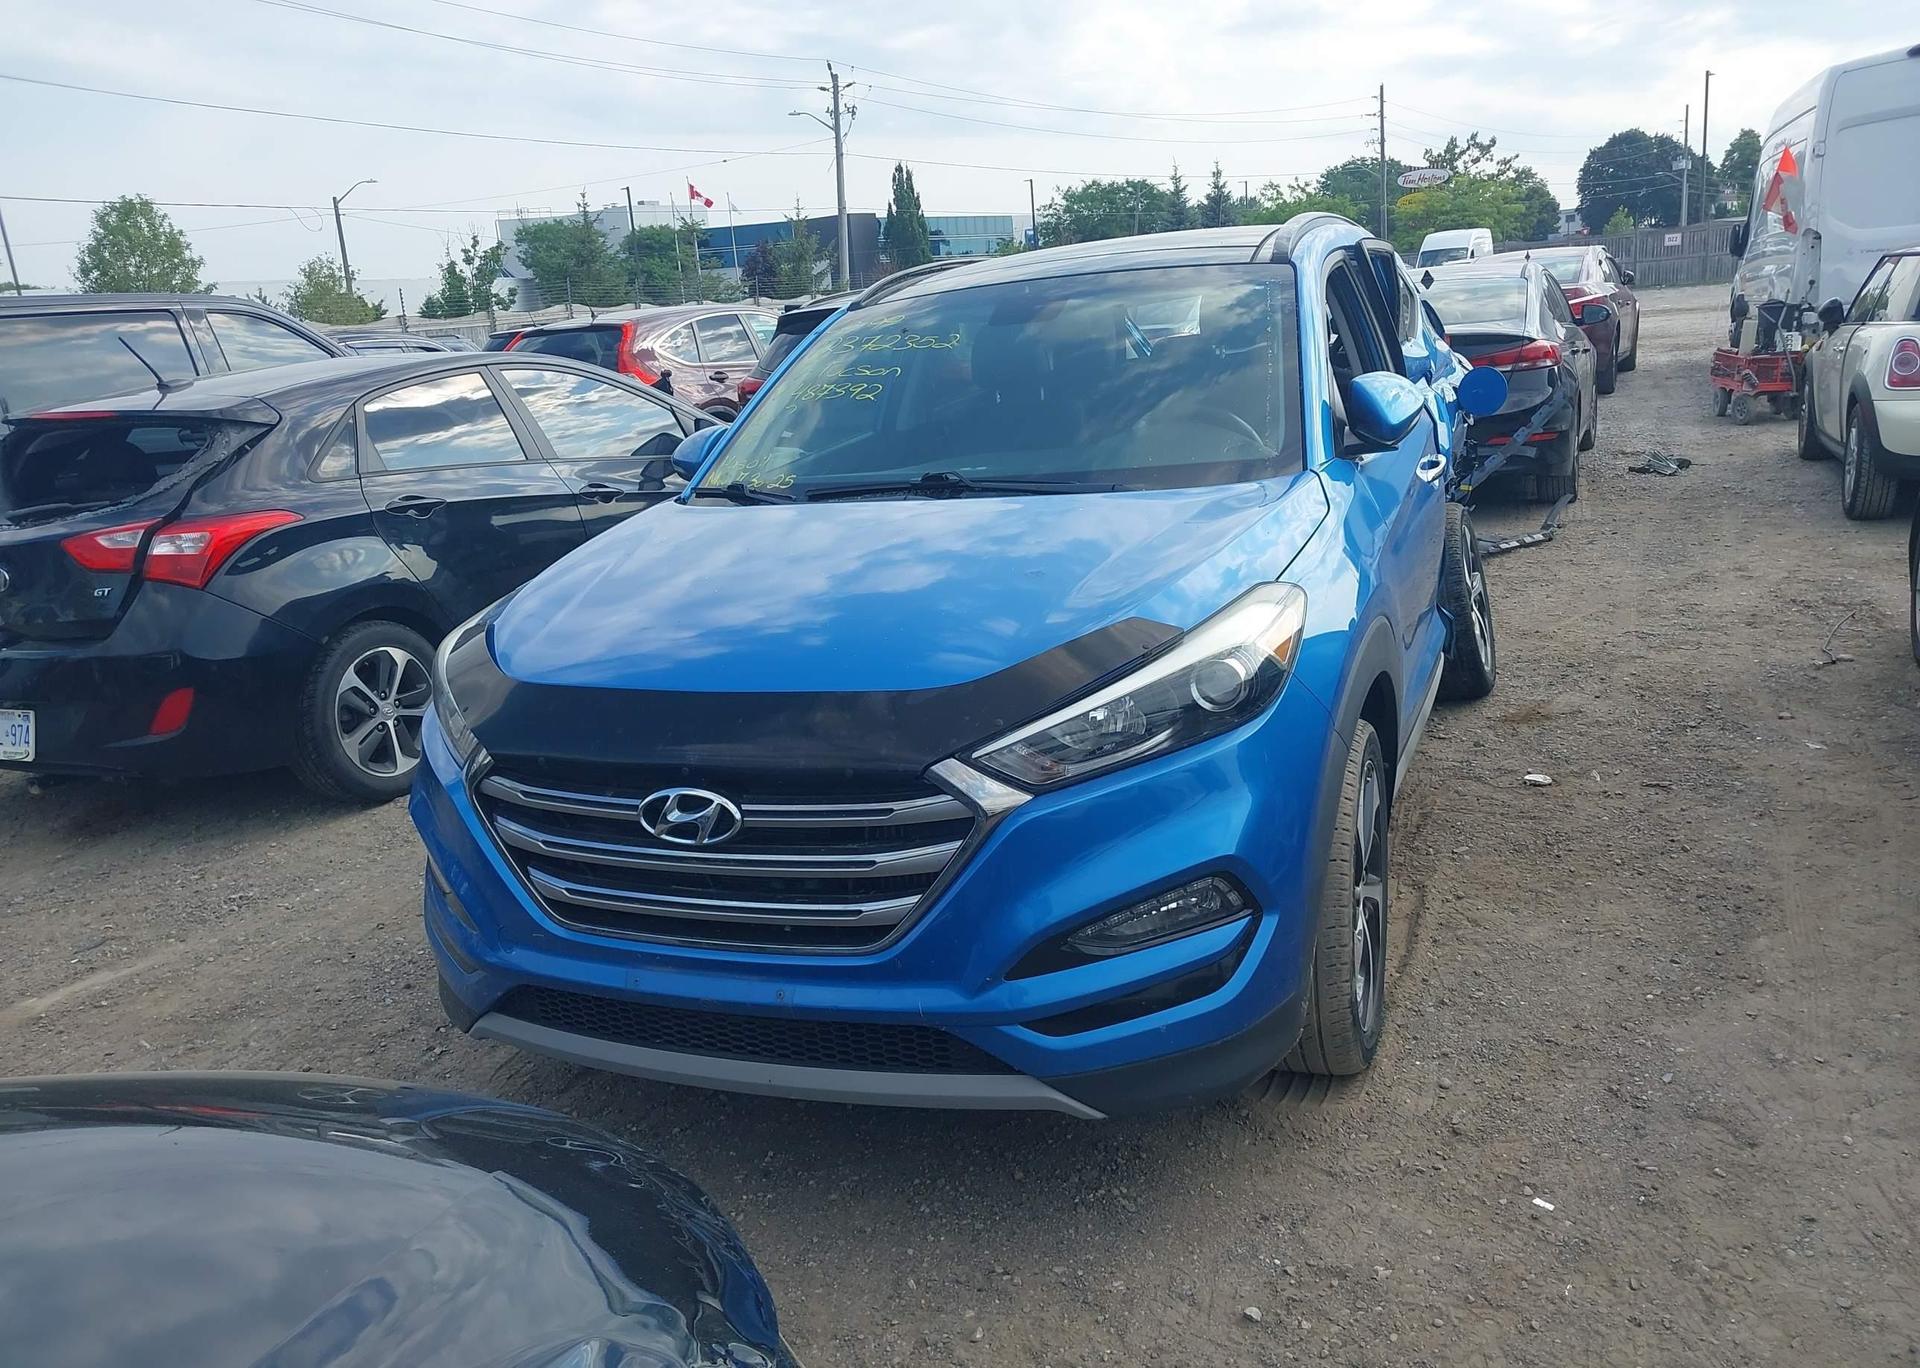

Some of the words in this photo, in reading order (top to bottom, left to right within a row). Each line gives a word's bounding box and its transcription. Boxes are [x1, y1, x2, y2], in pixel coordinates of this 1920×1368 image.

[1402, 174, 1416, 186] Tim
[94, 587, 112, 597] GT
[11, 723, 30, 748] 974
